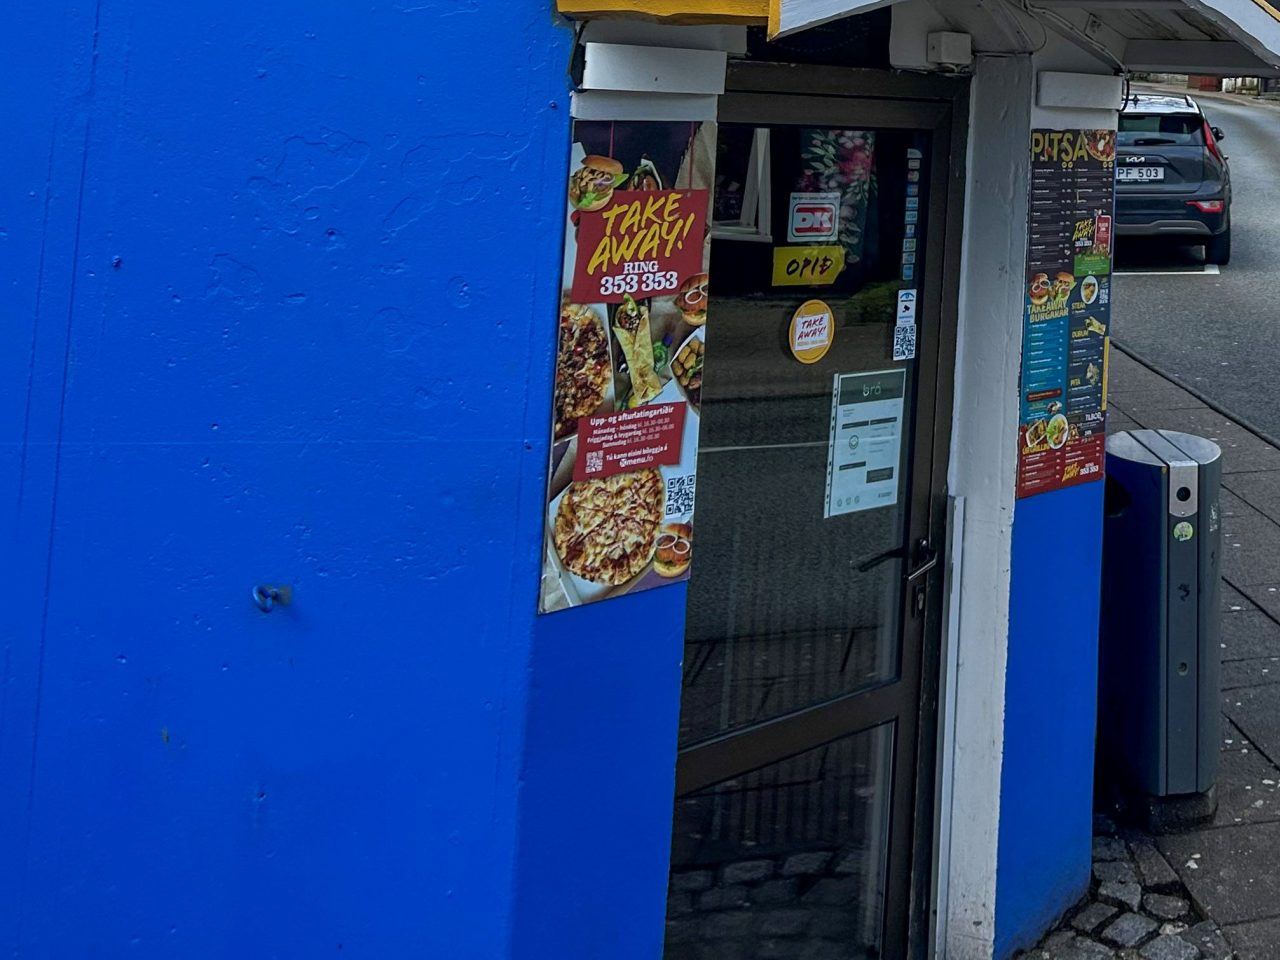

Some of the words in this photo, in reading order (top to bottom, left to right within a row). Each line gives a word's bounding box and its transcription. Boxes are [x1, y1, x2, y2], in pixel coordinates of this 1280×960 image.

[1031, 131, 1088, 161] PITSA
[1117, 168, 1133, 178] PF
[1138, 168, 1159, 178] 503
[602, 192, 683, 236] TAKE
[795, 211, 833, 229] DK
[587, 212, 695, 275] AWAY!
[623, 261, 659, 274] RING
[600, 275, 638, 295] 353
[641, 271, 678, 291] 353
[802, 316, 824, 329] TAKE
[797, 326, 826, 340] AWAY!
[608, 415, 617, 424] og
